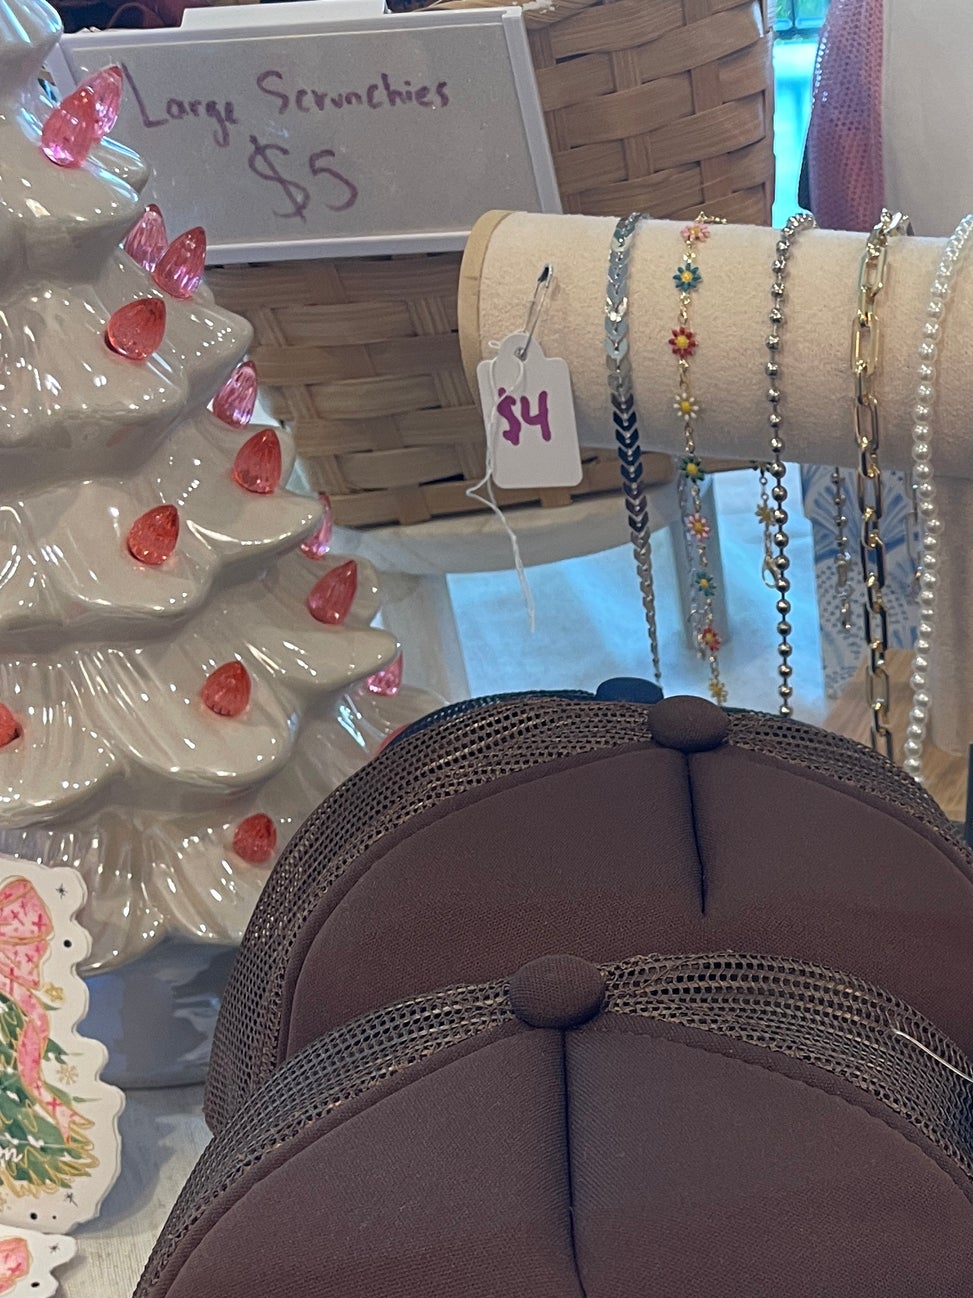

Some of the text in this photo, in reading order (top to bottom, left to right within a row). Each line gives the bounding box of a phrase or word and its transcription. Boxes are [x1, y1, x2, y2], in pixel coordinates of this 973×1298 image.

[118, 61, 451, 148] Large Scrunchies
[247, 135, 359, 219] $5
[496, 387, 552, 446] $4
